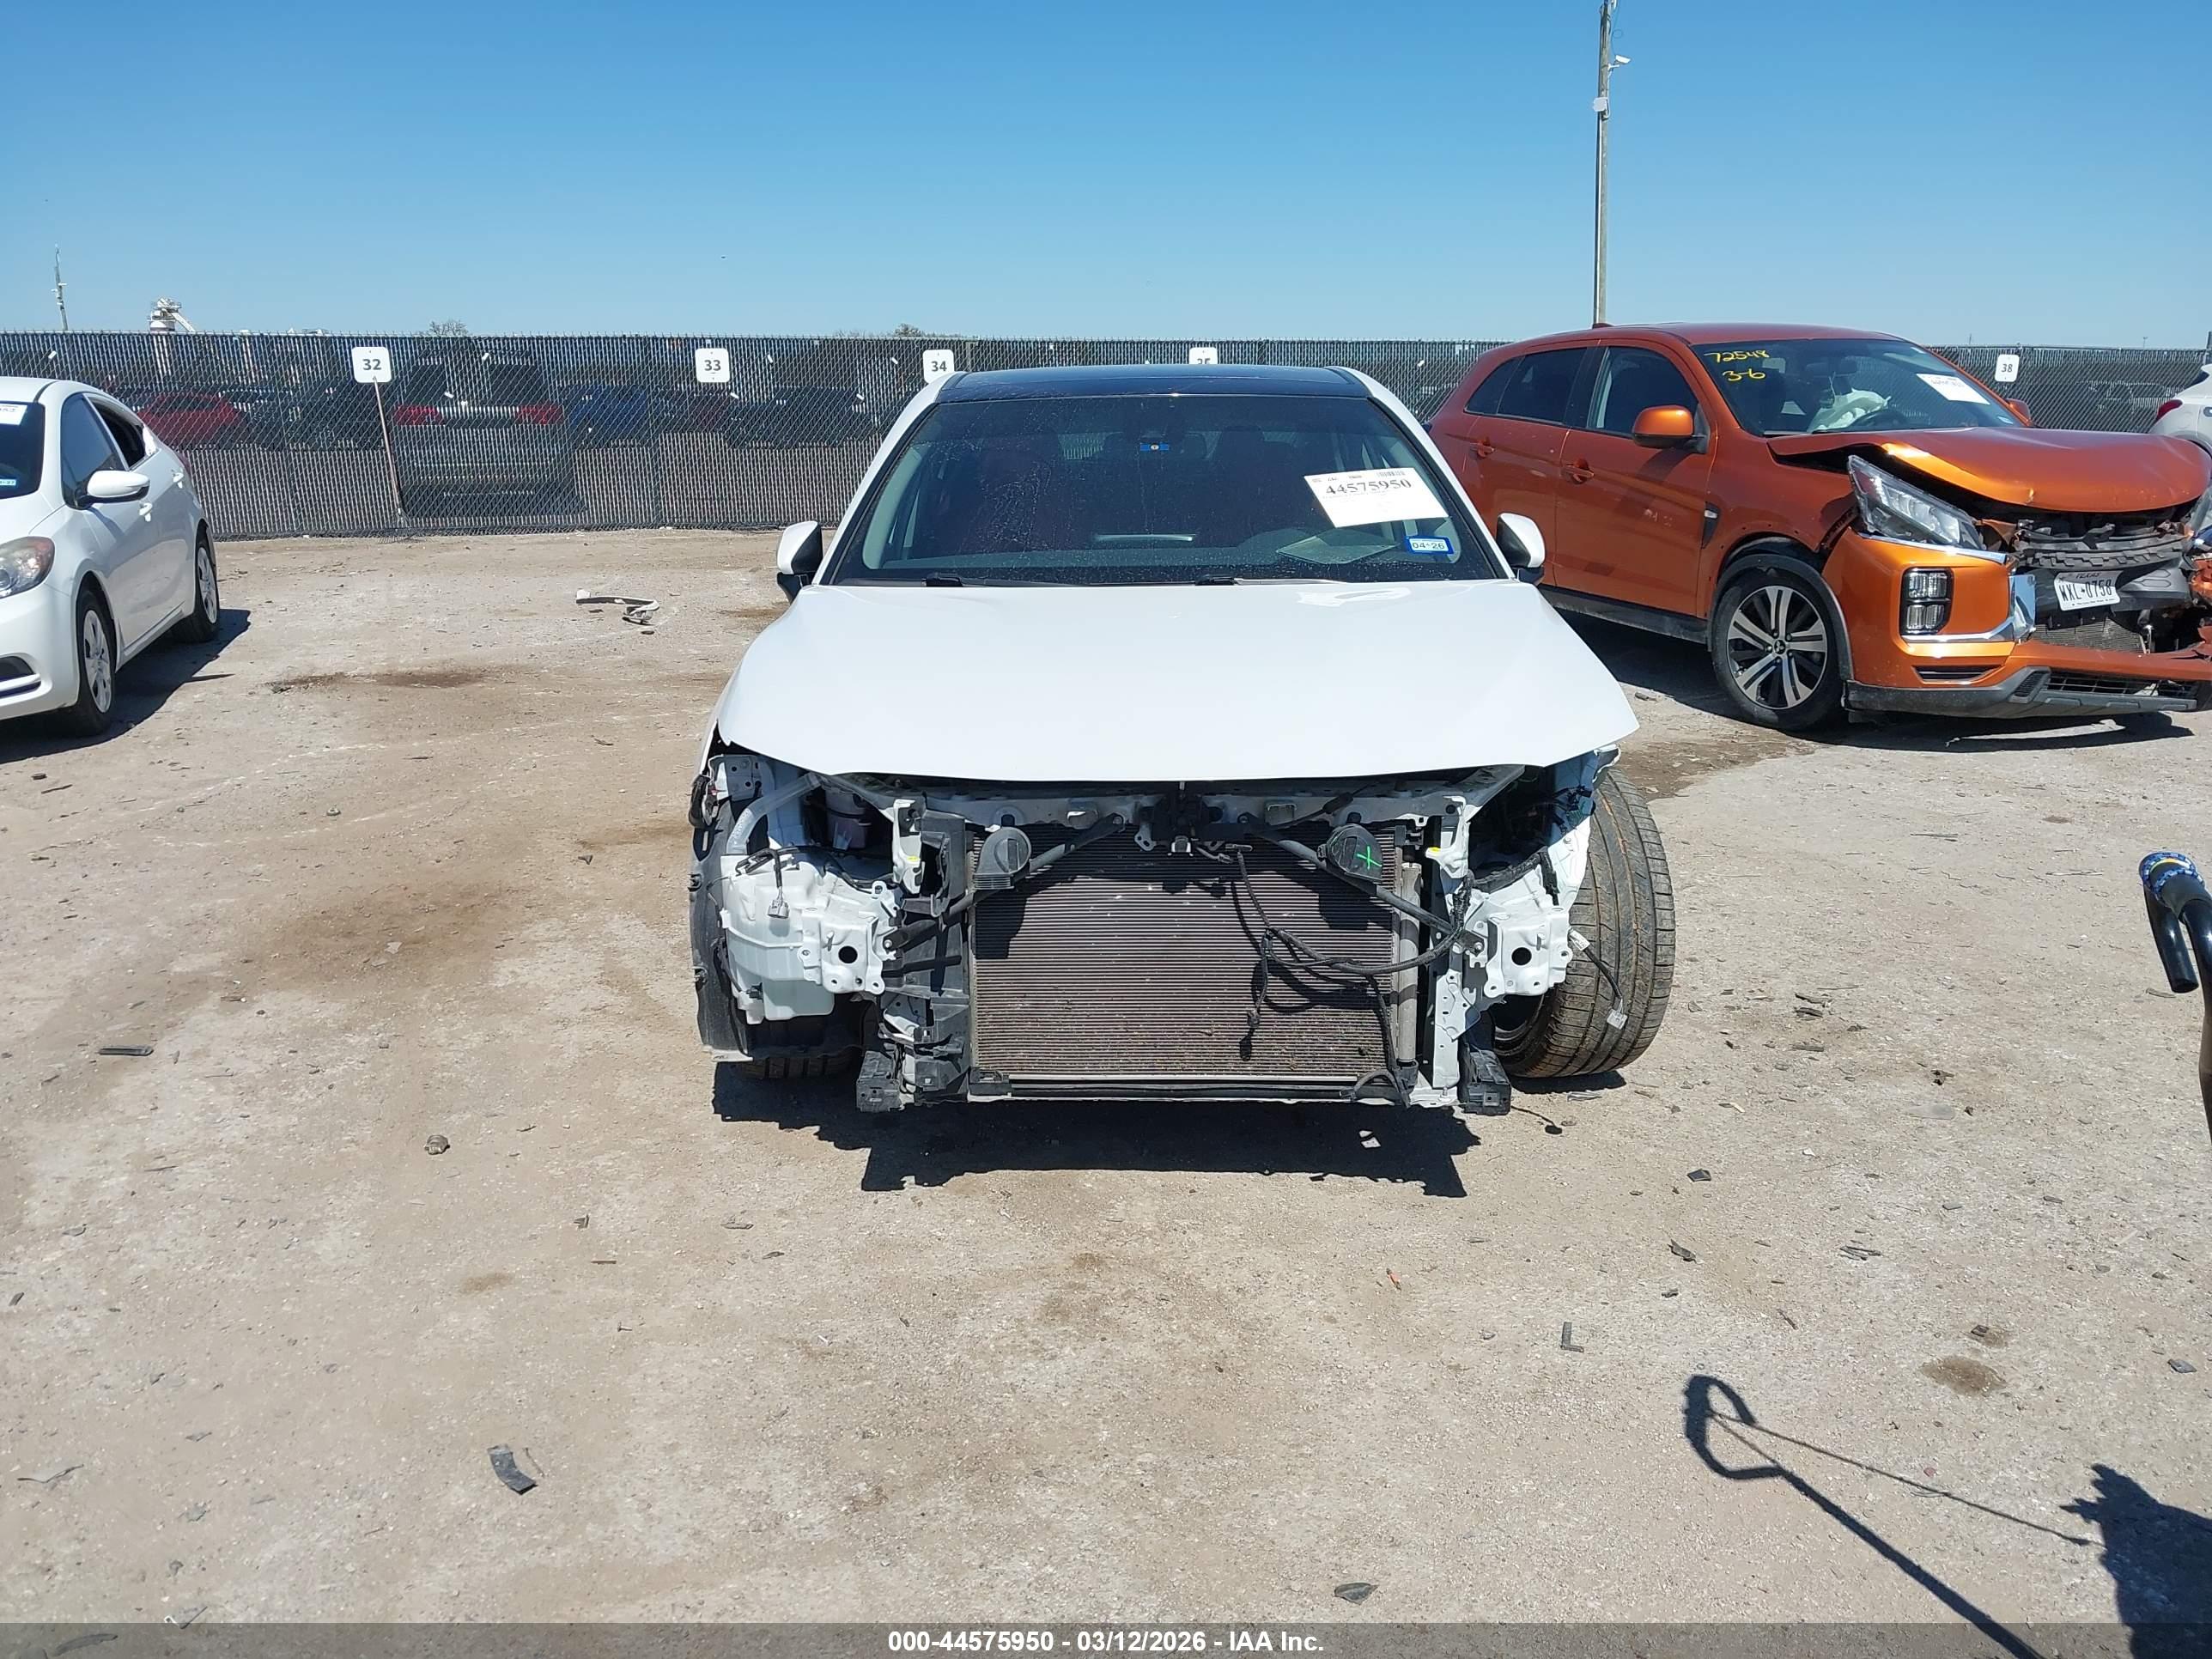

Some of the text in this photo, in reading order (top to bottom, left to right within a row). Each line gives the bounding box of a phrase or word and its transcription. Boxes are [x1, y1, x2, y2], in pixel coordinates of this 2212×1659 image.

[1703, 349, 1770, 363] 72548
[362, 358, 382, 371] 32
[704, 359, 721, 372] 33
[931, 360, 947, 372] 34
[2001, 363, 2013, 373] 38
[1722, 368, 1766, 382] 3-6
[1325, 478, 1413, 495] 44575950
